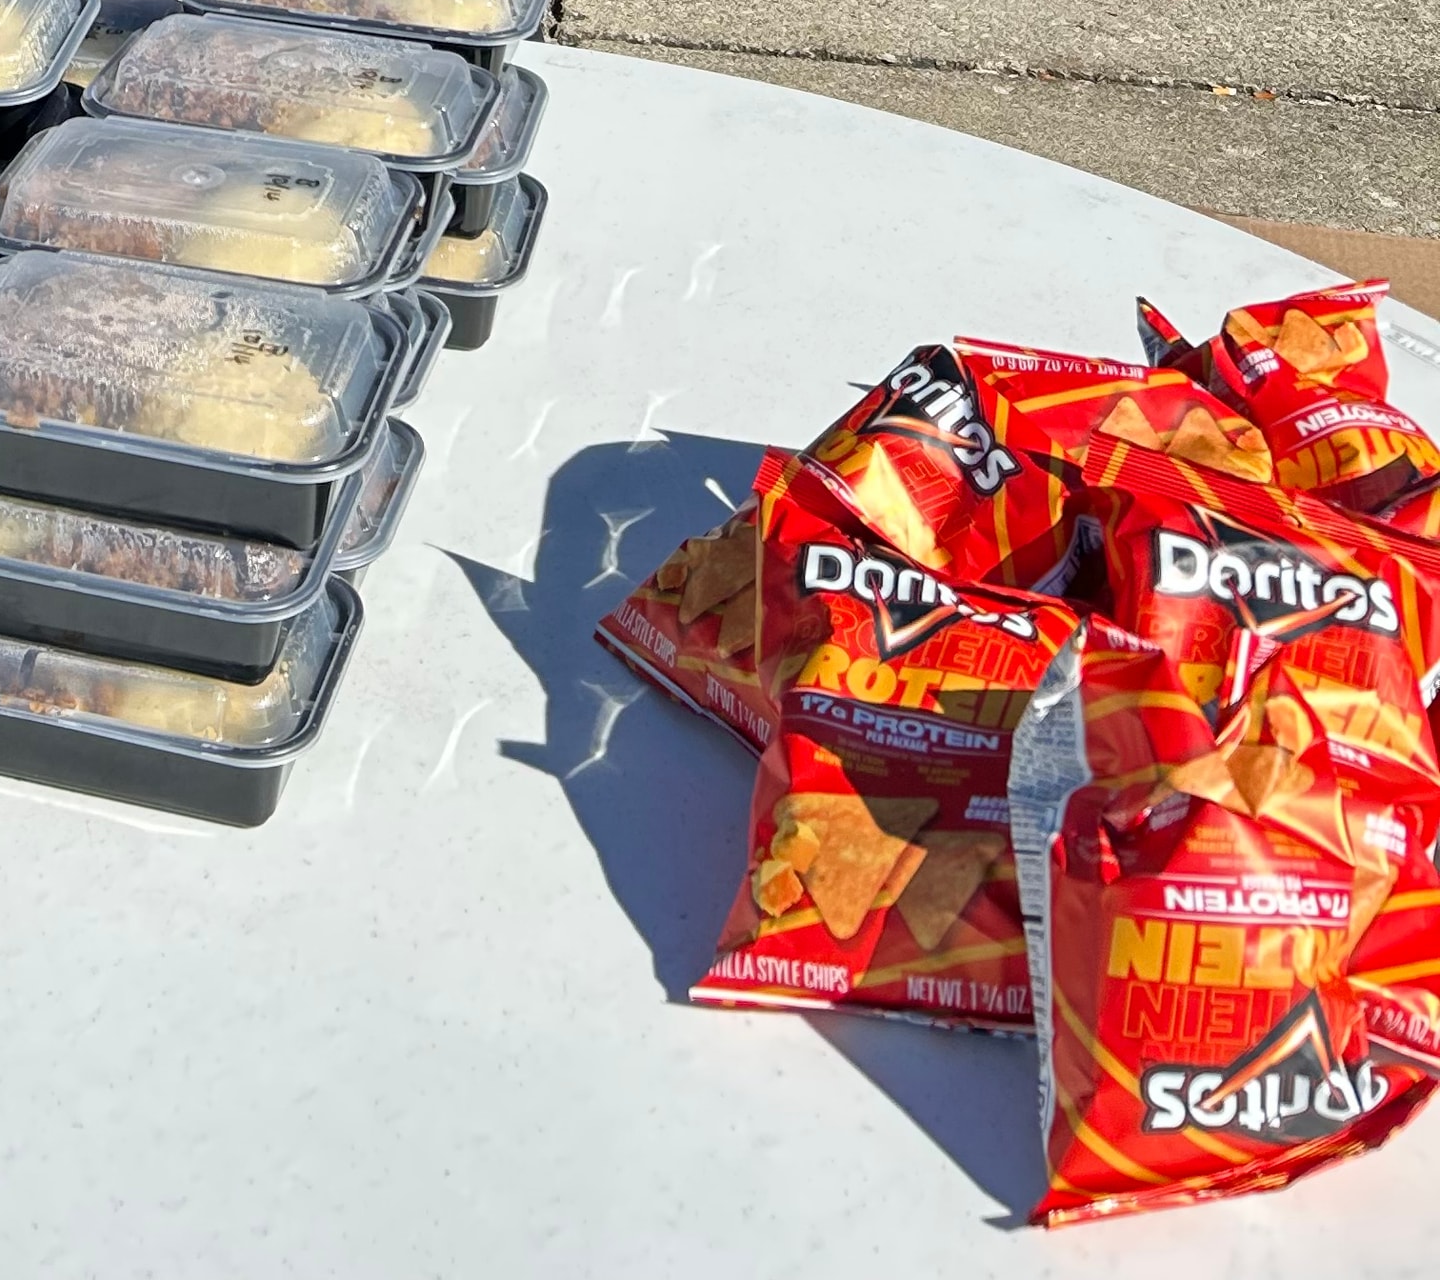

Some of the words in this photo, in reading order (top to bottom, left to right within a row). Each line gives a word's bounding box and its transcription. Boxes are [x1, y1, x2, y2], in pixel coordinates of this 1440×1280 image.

[889, 362, 1017, 490] oritos
[1155, 531, 1400, 632] Doritos
[630, 613, 657, 651] STYLE
[653, 631, 678, 668] CHIPS
[852, 707, 1000, 751] PROTEIN
[865, 729, 885, 745] PER
[886, 732, 929, 754] PACKAGE
[1163, 885, 1319, 918] PROTEIN
[756, 956, 801, 987] STYLE
[803, 962, 849, 994] CHIPS
[907, 976, 938, 1002] NET
[938, 978, 968, 1010] WT.
[969, 982, 976, 1011] 1
[1147, 1060, 1389, 1132] Doritos
